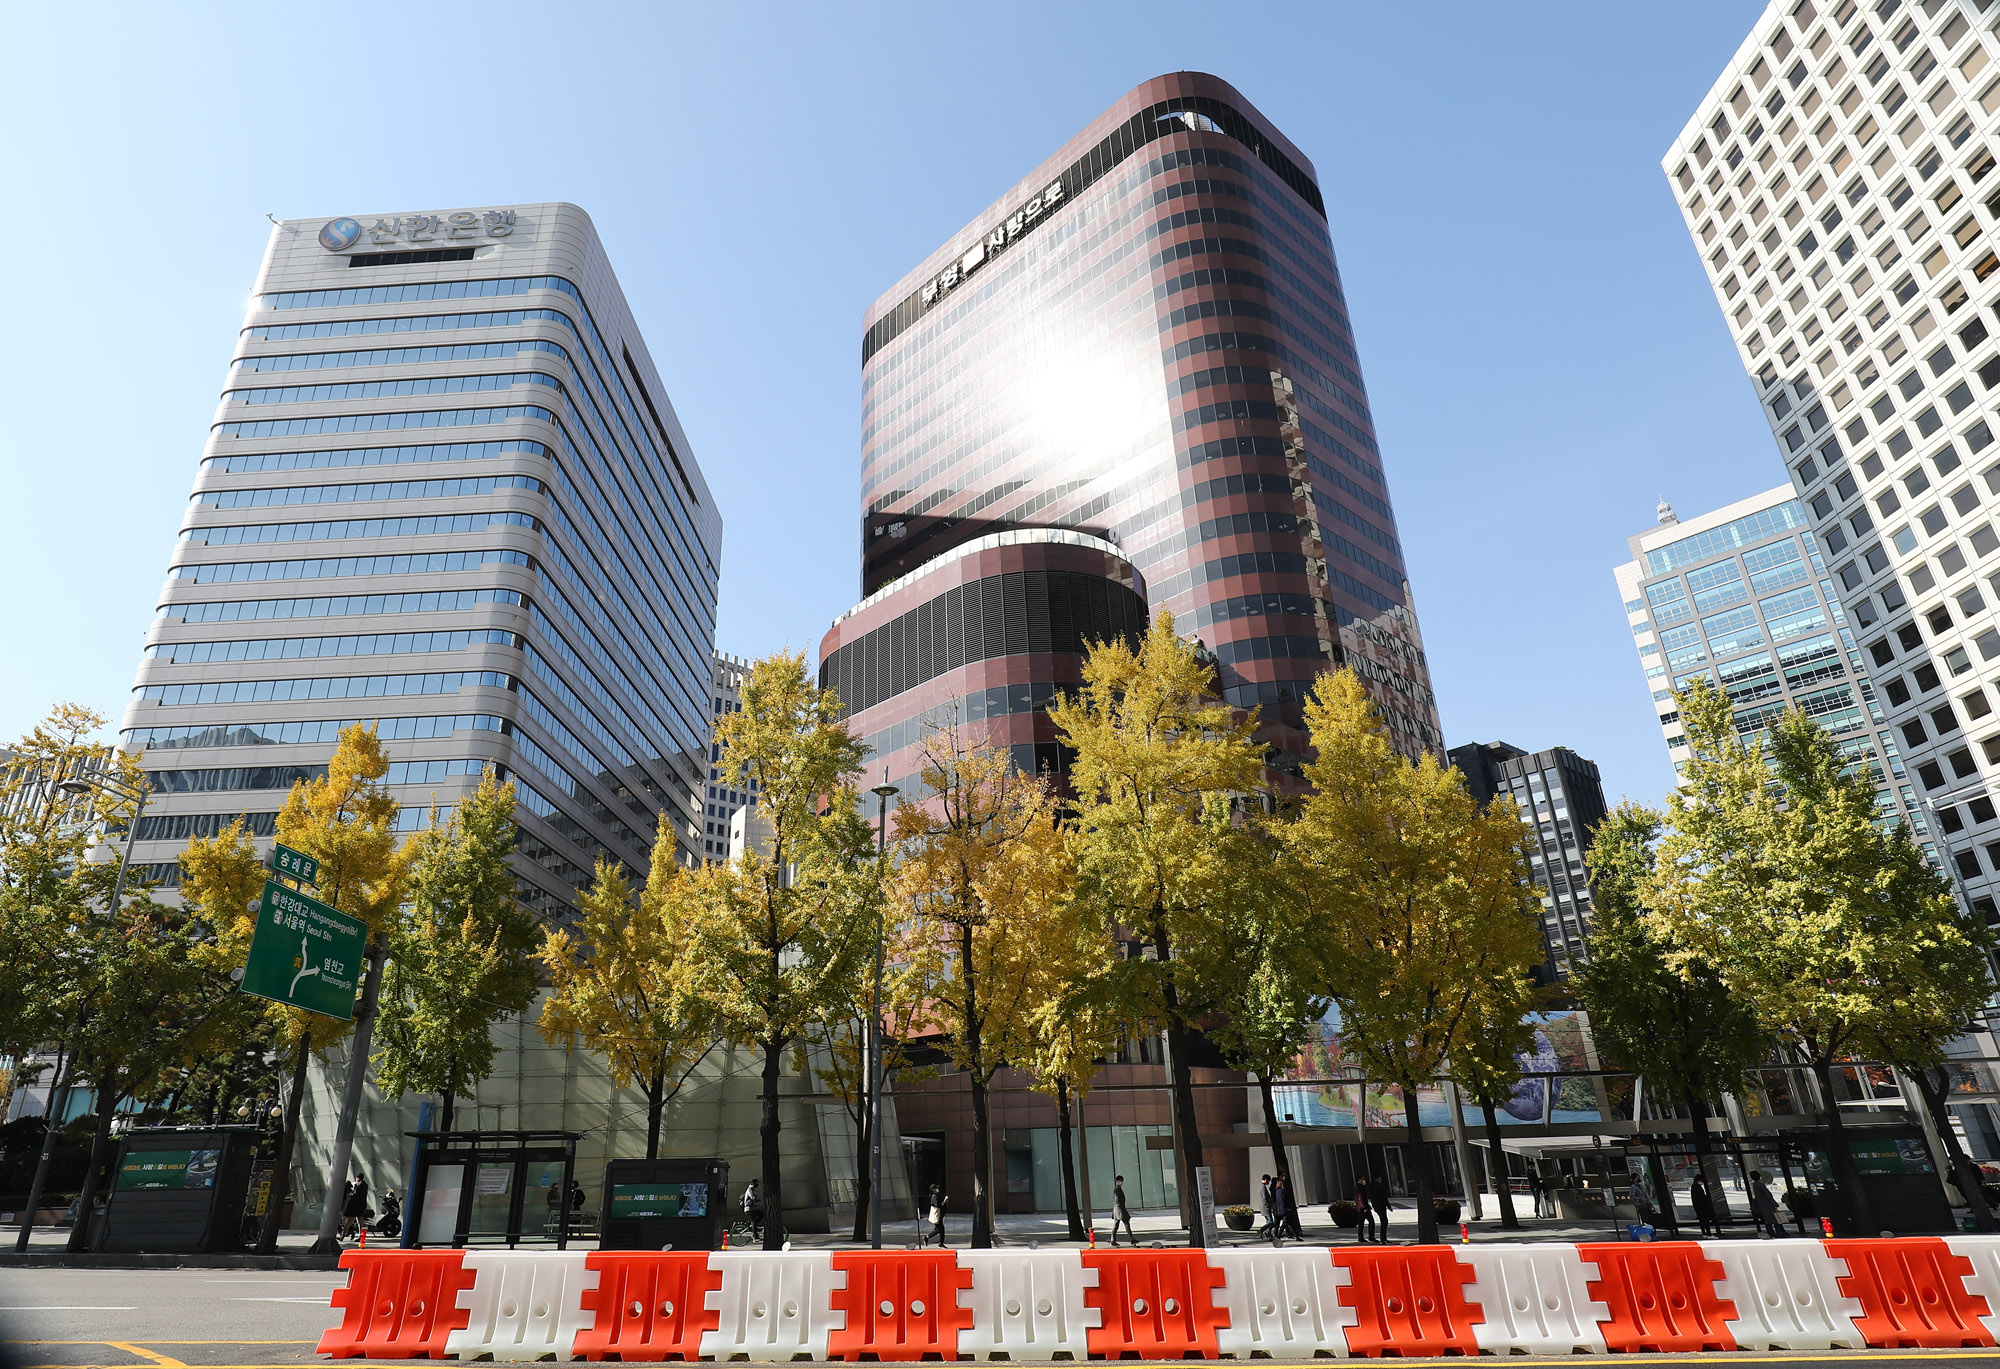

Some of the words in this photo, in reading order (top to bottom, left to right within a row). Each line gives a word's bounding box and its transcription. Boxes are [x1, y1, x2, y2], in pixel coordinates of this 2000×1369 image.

[367, 210, 517, 244] 신한은행
[922, 263, 958, 304] 부영
[987, 180, 1065, 249] 사랑으로
[280, 852, 312, 877] 숭례문
[279, 894, 309, 918] 한강대교
[309, 908, 358, 938] Hangangdaegyo(Br)
[283, 913, 307, 934] 서울역
[306, 923, 323, 938] Seoul
[322, 930, 333, 942] Stn
[324, 957, 345, 976] 염천교
